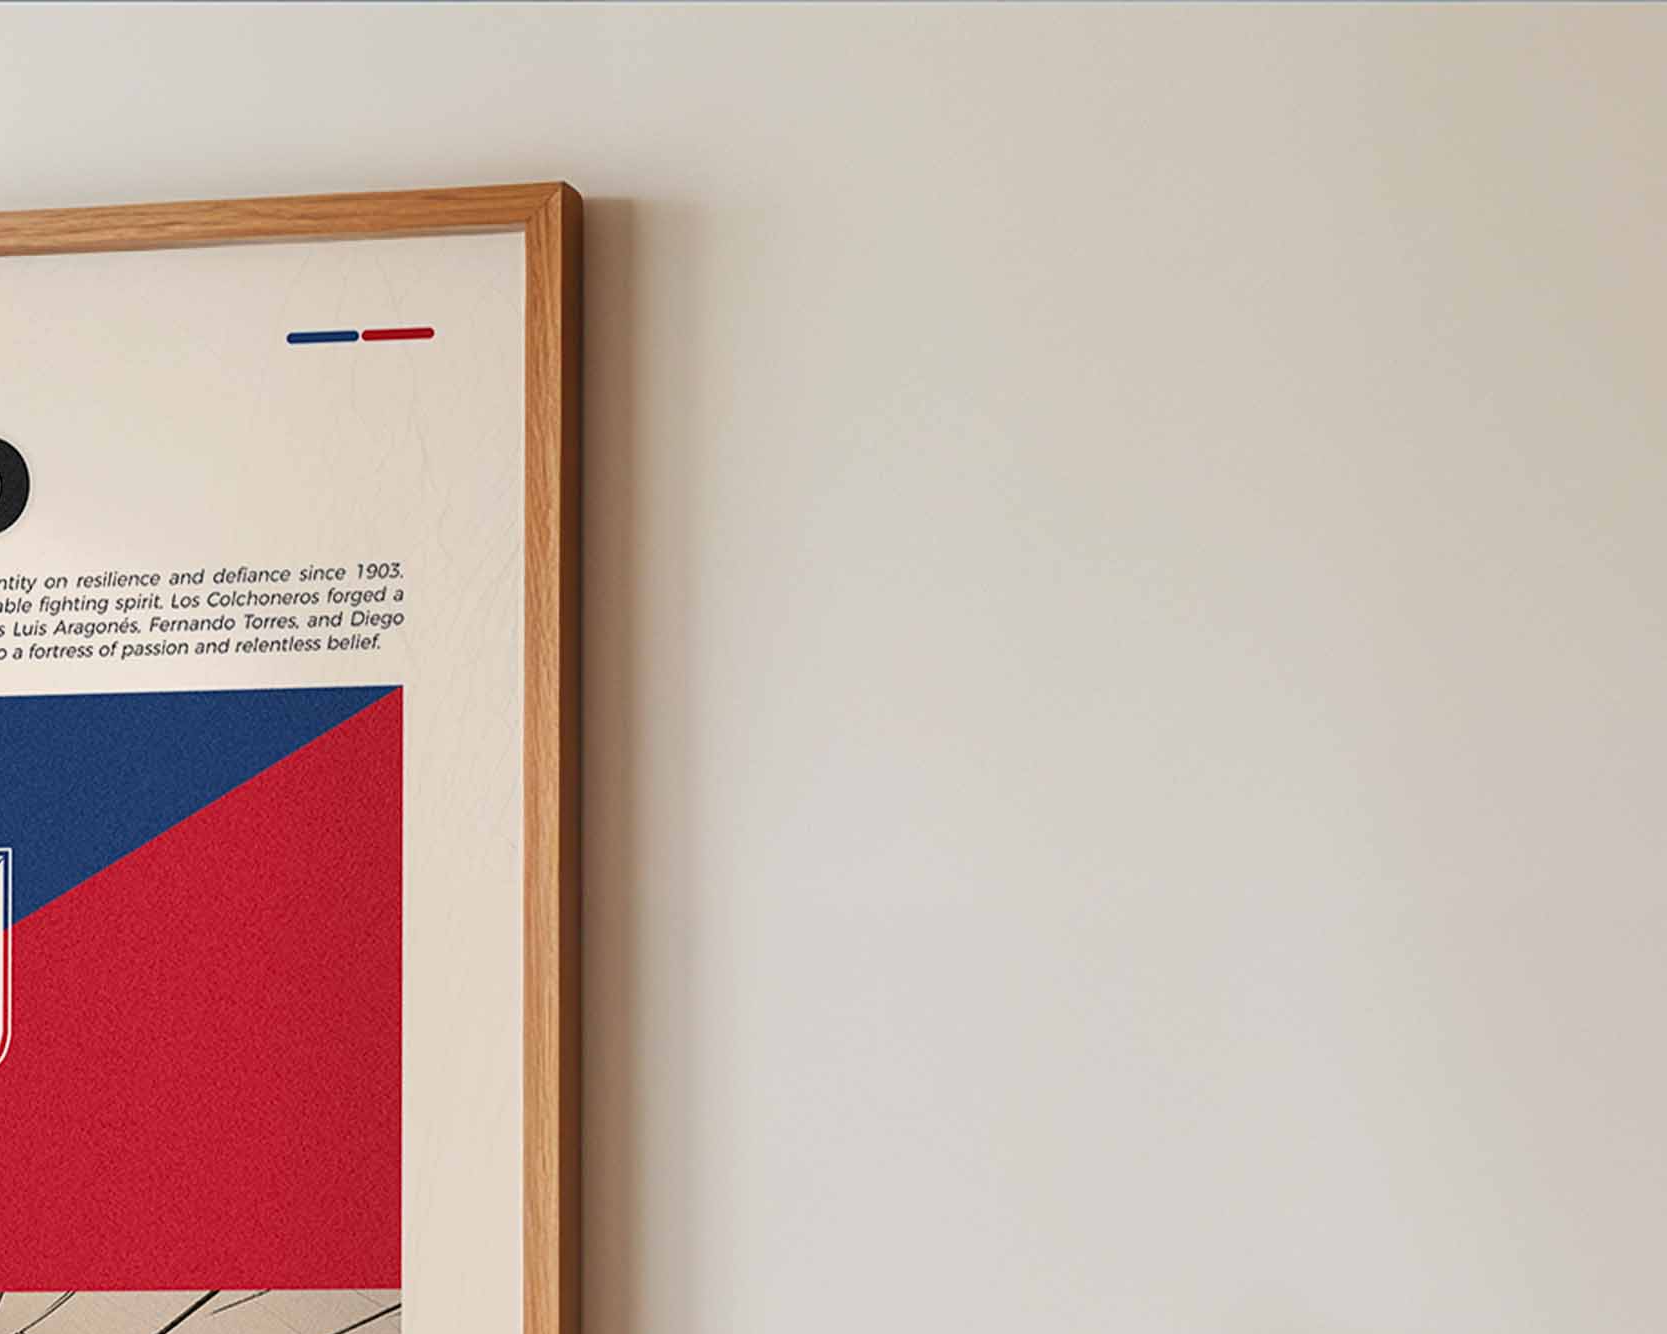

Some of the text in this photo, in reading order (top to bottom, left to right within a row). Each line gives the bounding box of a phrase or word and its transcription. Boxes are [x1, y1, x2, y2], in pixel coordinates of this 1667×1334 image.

[43, 576, 69, 590] on
[76, 570, 162, 589] resilience
[168, 568, 206, 587] and
[212, 565, 292, 585] defiance
[298, 564, 347, 583] since
[357, 561, 404, 580] 1903.
[38, 594, 110, 616] fighting
[170, 592, 201, 610] Los
[206, 589, 320, 609] Colchoneros
[326, 585, 388, 607] forged
[392, 588, 405, 603] a
[12, 619, 48, 638] Luis
[148, 614, 236, 633] Fernando
[306, 610, 344, 629] and
[350, 609, 406, 630] Diego
[11, 647, 24, 661] a
[28, 642, 94, 660] fortress
[98, 640, 119, 658] of
[120, 639, 190, 660] passion
[194, 637, 231, 655] and
[234, 635, 322, 654] relentless
[326, 632, 381, 651] belief.
